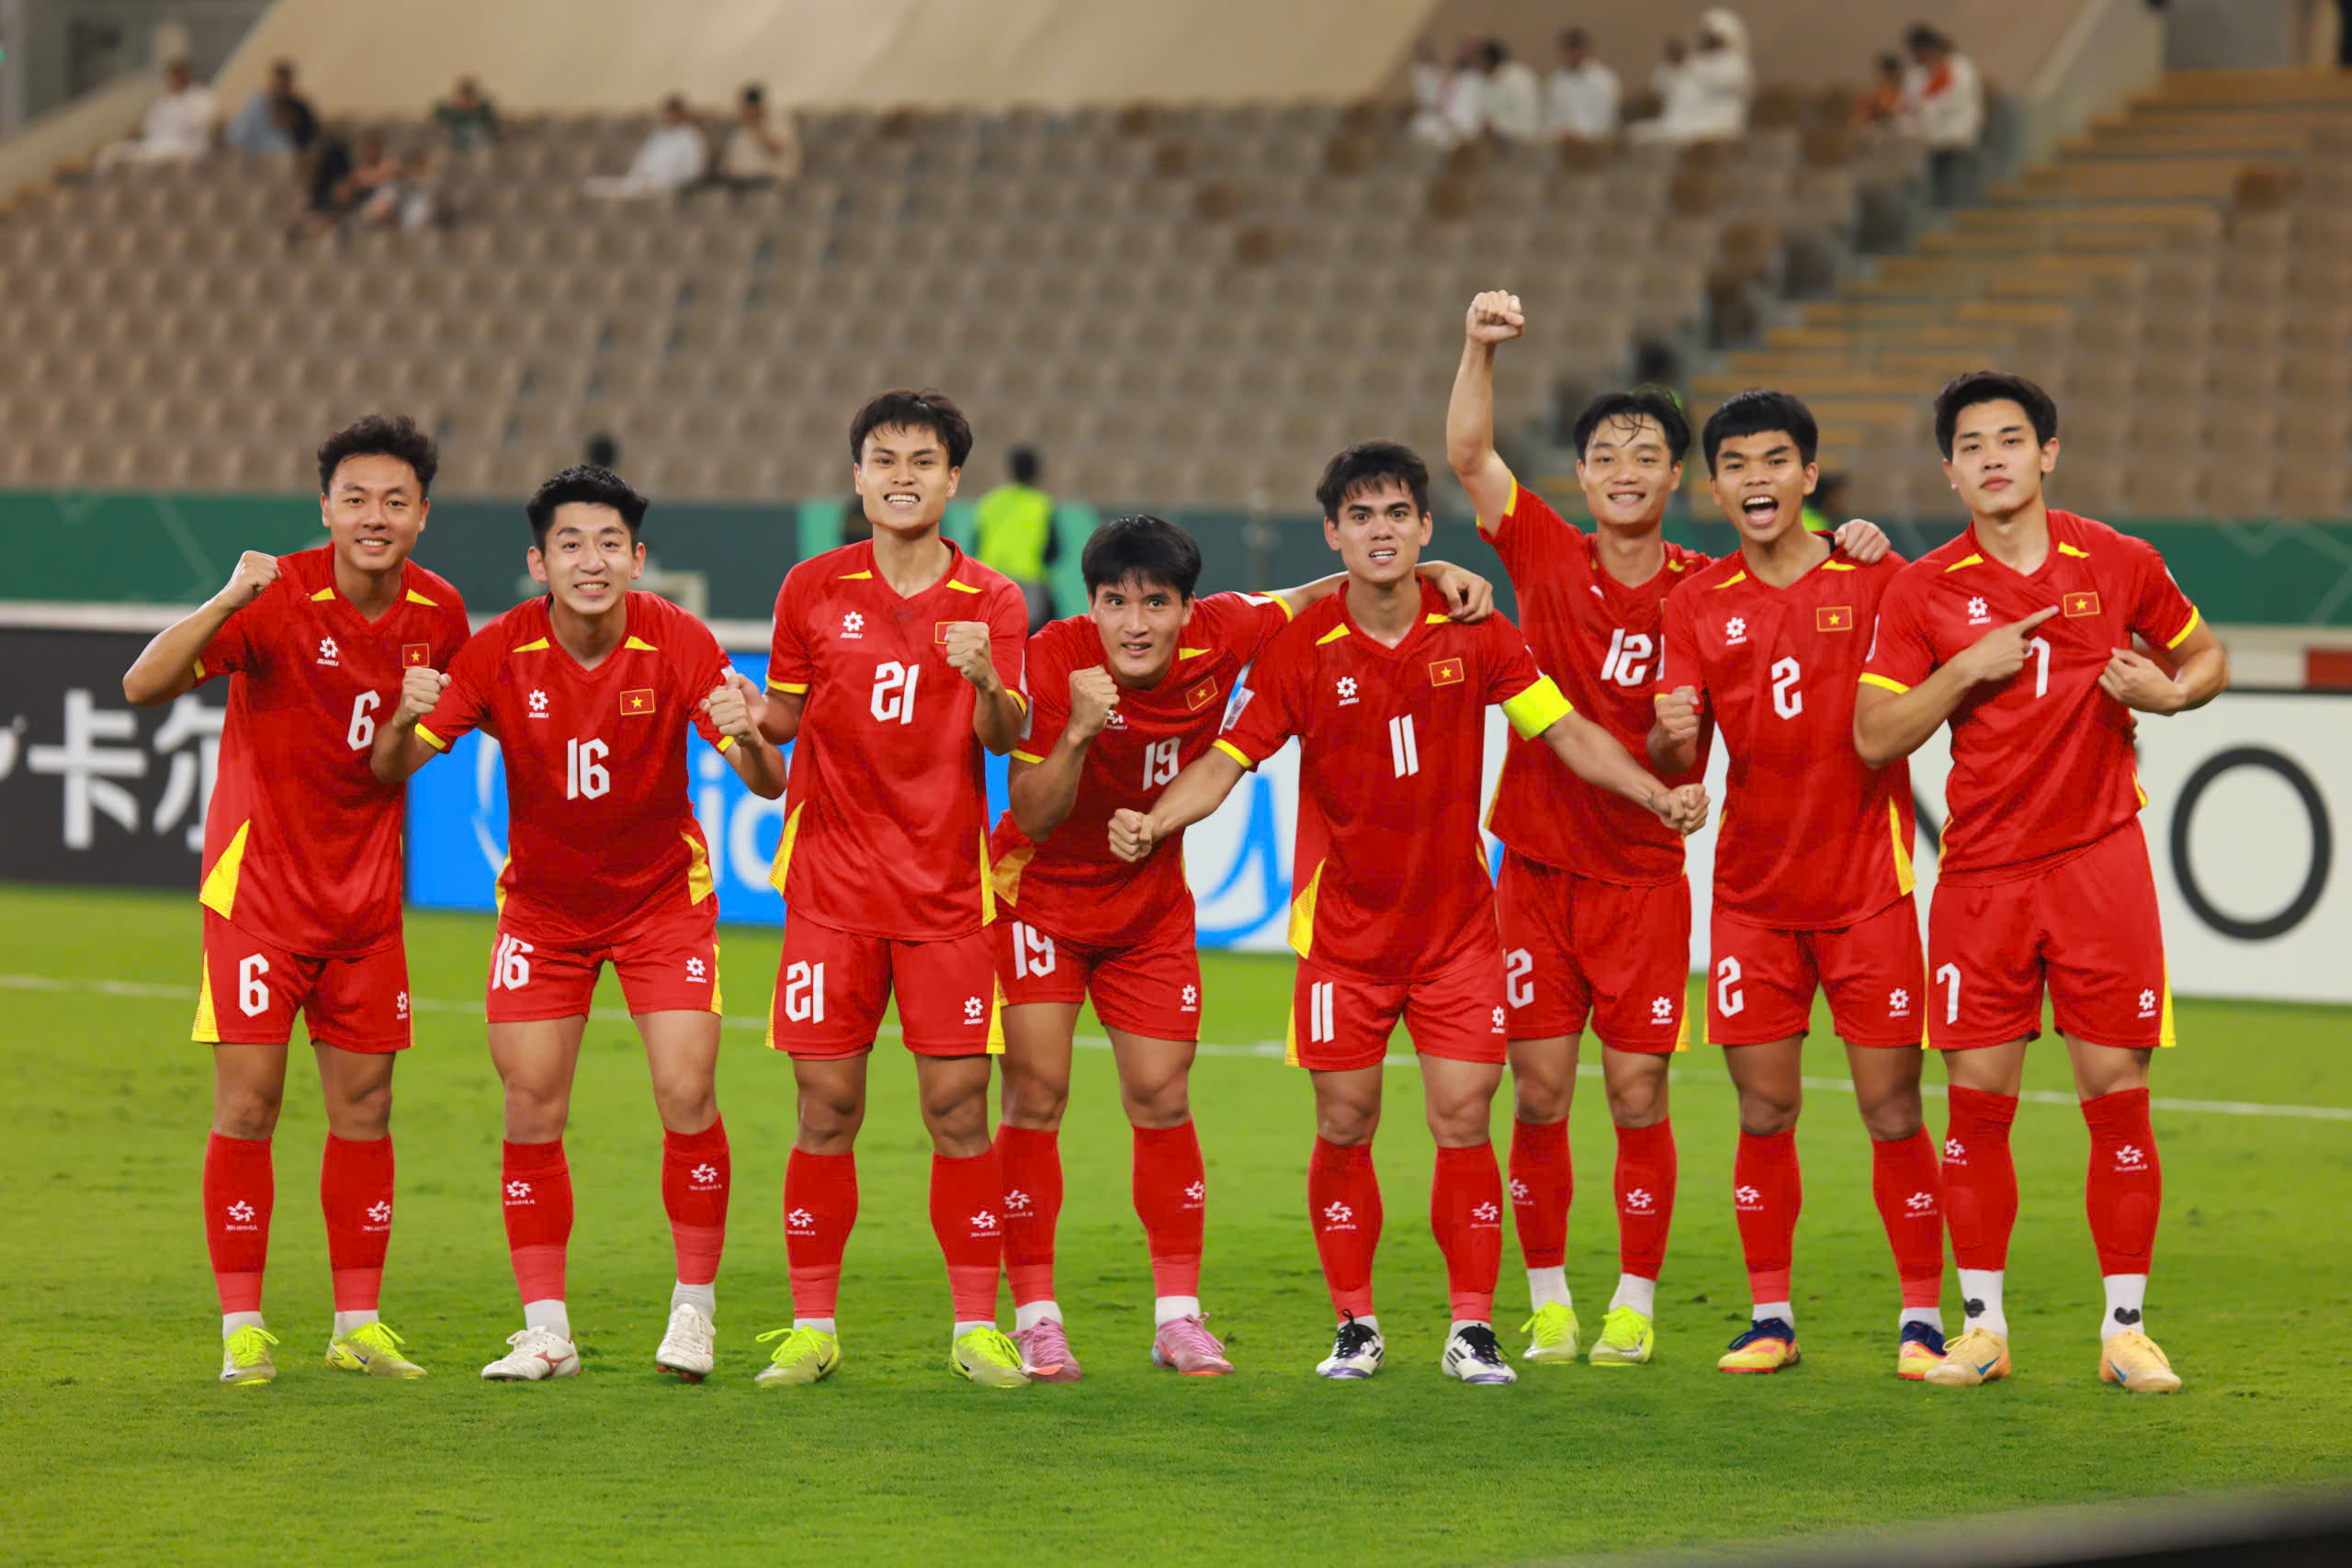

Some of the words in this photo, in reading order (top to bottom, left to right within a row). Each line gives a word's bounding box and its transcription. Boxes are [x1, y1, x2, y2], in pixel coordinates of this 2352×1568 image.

[1600, 628, 1653, 686] 12
[1770, 656, 1803, 720] 2
[2024, 636, 2051, 699] 7
[346, 689, 380, 750] 6
[869, 660, 920, 725] 21
[567, 737, 610, 800] 16
[1142, 737, 1182, 792] 19
[1388, 713, 1419, 779] 11
[492, 932, 535, 991] 16
[1012, 920, 1056, 980] 19
[239, 953, 269, 1018] 6
[785, 960, 824, 1024] 21
[1310, 981, 1335, 1043] 11
[1717, 955, 1745, 1018] 2
[1936, 961, 1961, 1025] 7
